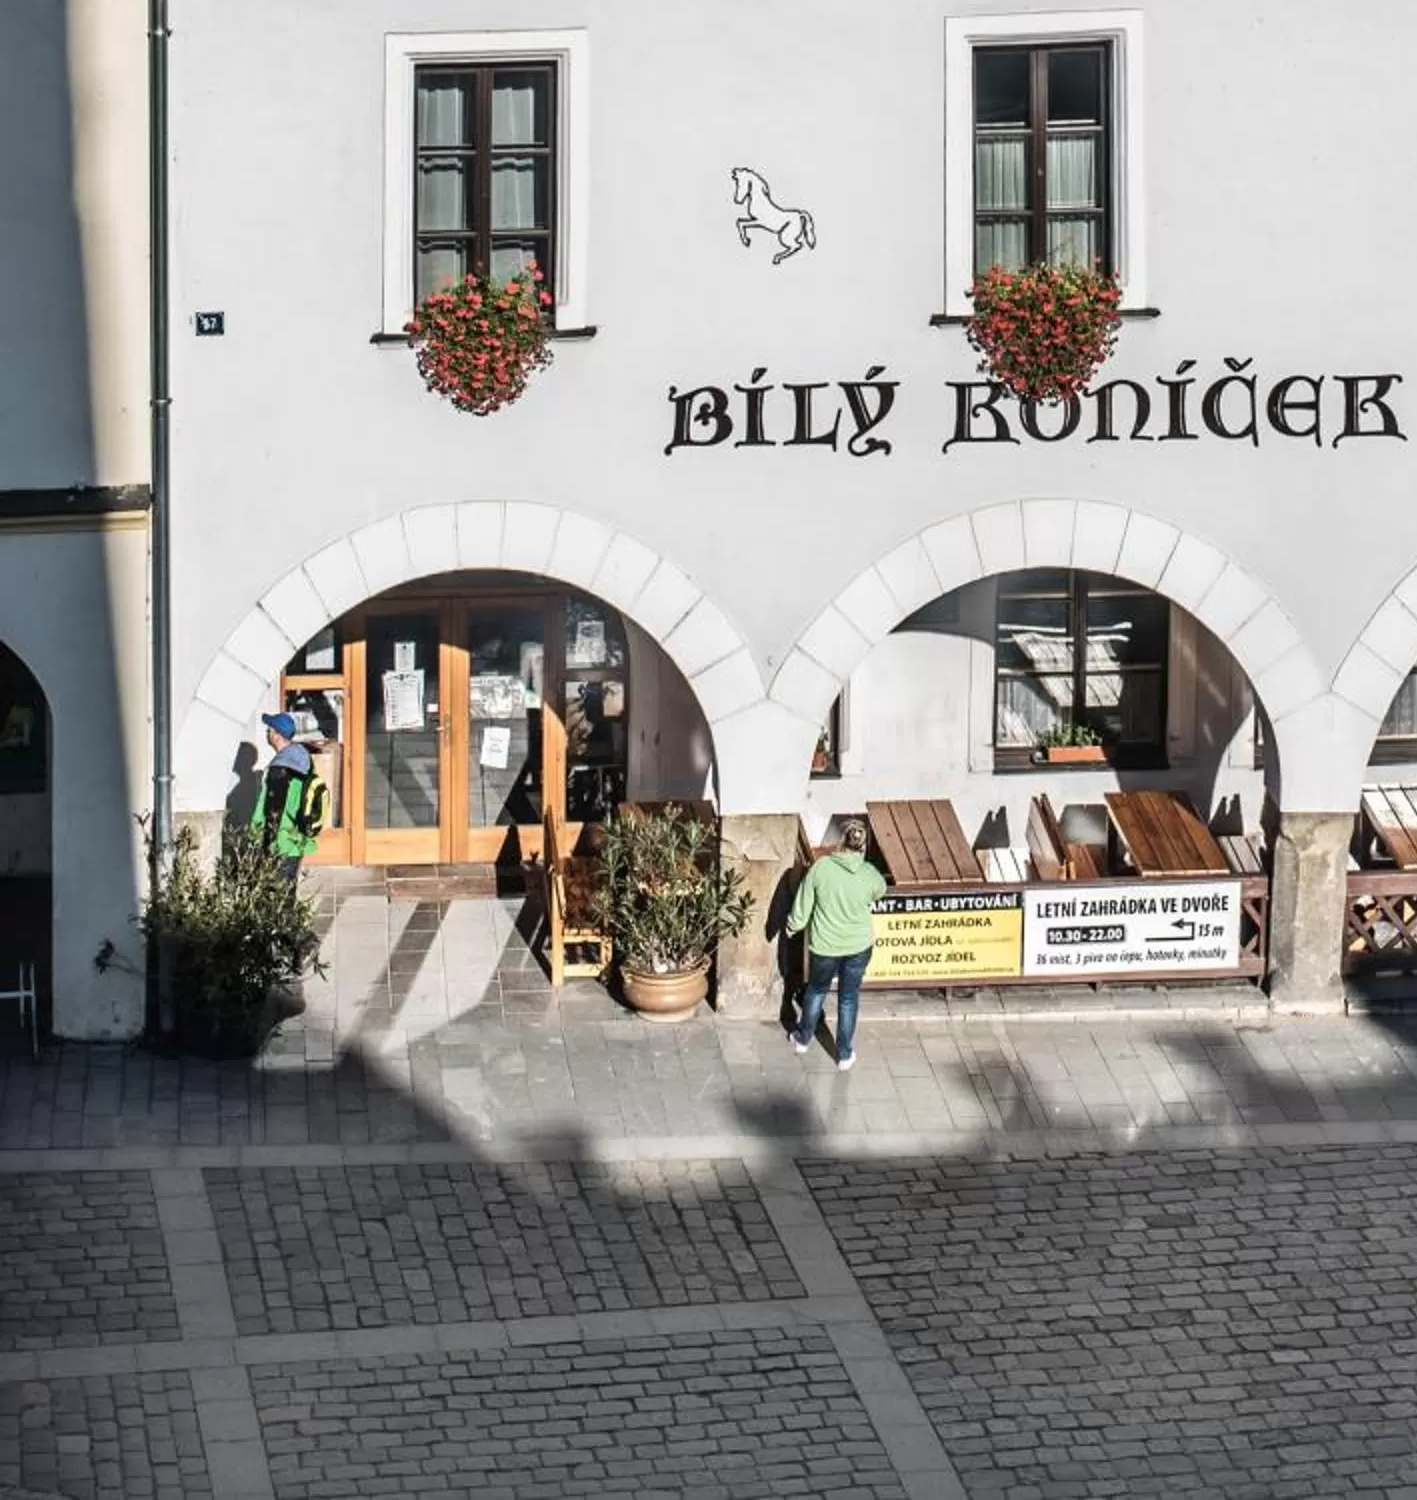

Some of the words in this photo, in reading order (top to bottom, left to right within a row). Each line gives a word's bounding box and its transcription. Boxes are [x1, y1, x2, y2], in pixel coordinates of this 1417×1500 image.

[664, 365, 901, 457] BÍLÝ
[905, 899, 934, 910] BAR
[940, 894, 1018, 909] UBYTOVÁNÍ
[1036, 897, 1077, 918] LETNÍ
[1080, 896, 1157, 917] ZAHRÁDKA
[1160, 897, 1177, 913] VE
[1181, 893, 1229, 912] DVOŘE
[1199, 923, 1210, 937] 15
[1211, 925, 1225, 937] m
[891, 953, 942, 964] ROZVOZ
